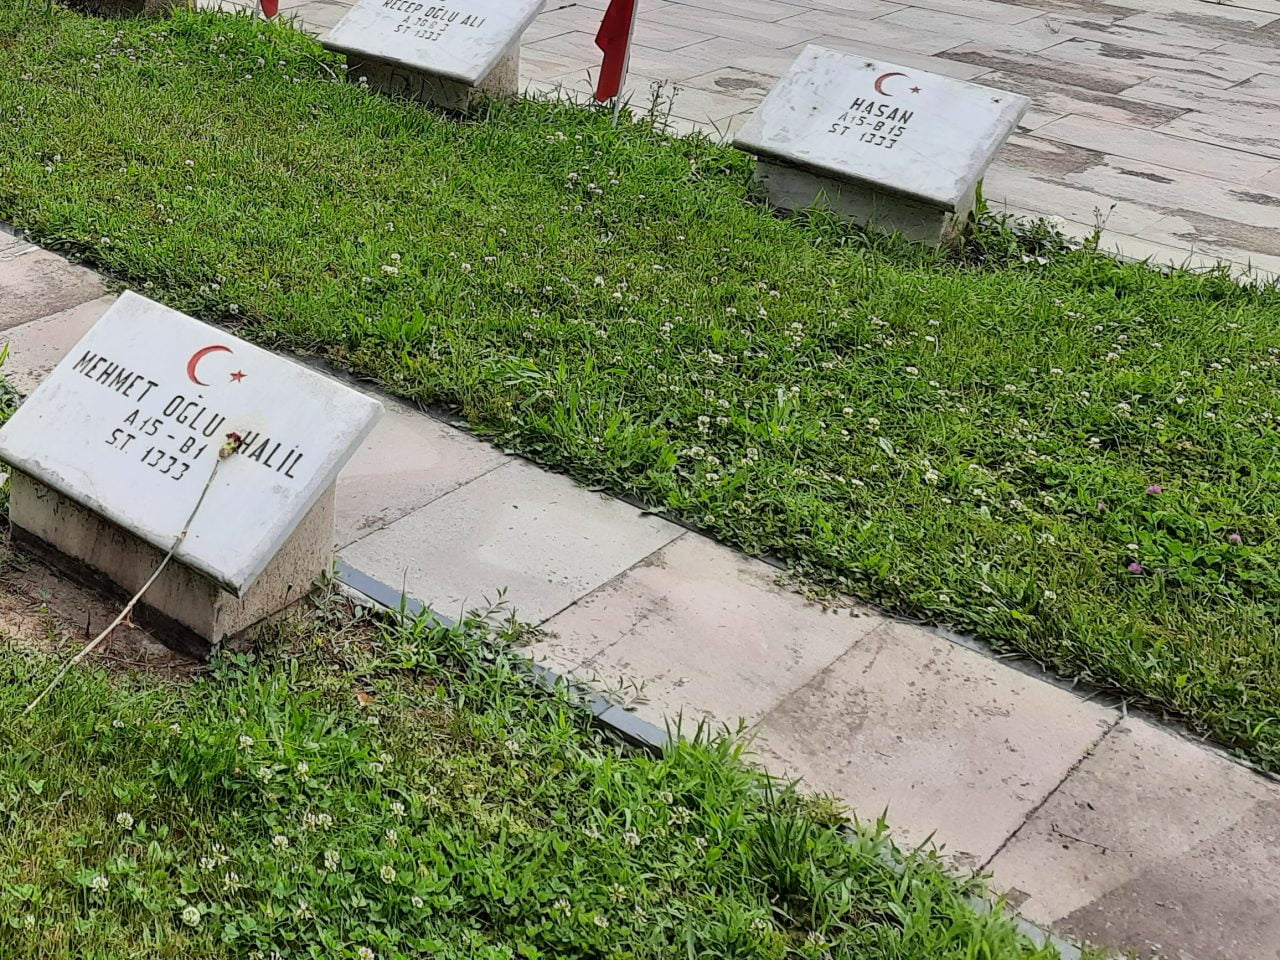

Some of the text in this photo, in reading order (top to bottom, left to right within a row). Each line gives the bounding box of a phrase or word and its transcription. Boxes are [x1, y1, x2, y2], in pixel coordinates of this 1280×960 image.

[424, 5, 460, 23] OĞLU
[393, 24, 442, 41] ST 1333
[849, 97, 914, 125] HASAN
[828, 123, 898, 149] ST 1333
[72, 350, 304, 479] MEHMET OĞLU HALİL
[140, 446, 191, 481] 1333
